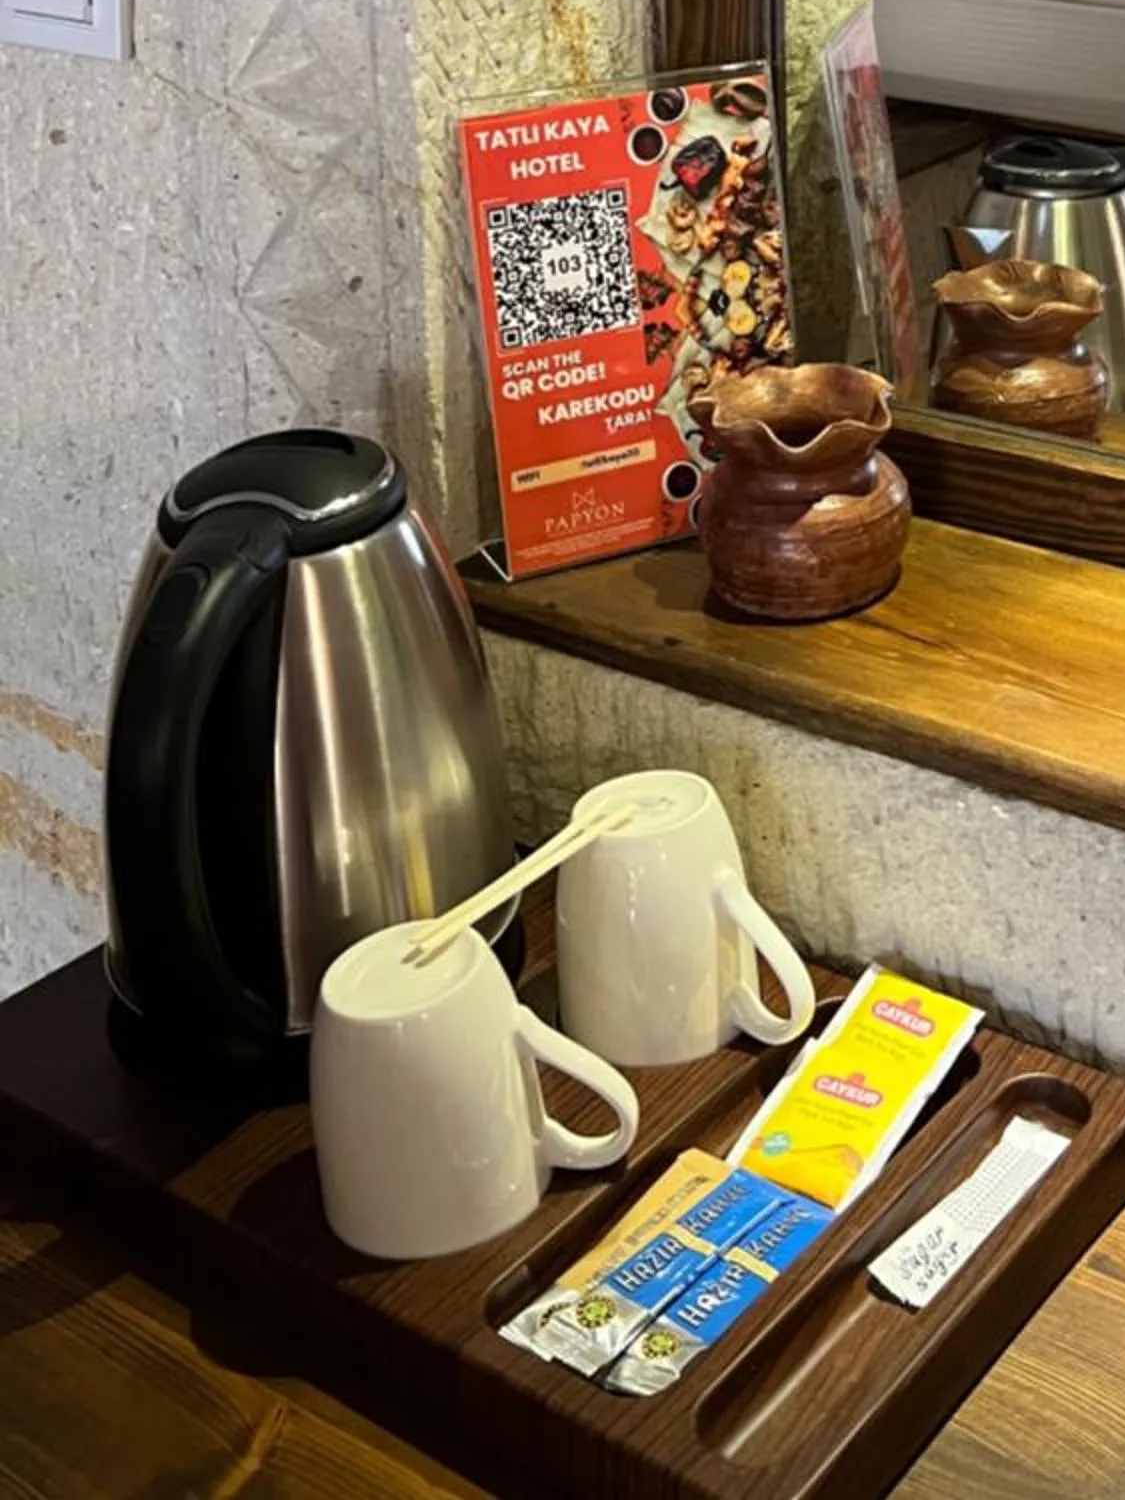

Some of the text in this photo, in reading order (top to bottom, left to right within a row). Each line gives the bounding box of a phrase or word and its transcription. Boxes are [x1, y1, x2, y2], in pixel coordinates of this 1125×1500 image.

[474, 115, 610, 151] TATLI KAYA
[510, 152, 585, 180] HOTEL
[547, 256, 581, 275] 103
[502, 350, 582, 378] SCAN THE
[502, 362, 605, 400] QR CODE!
[538, 383, 654, 425] KAREKODU
[605, 408, 651, 431] TARA!
[545, 501, 625, 533] PAPYON
